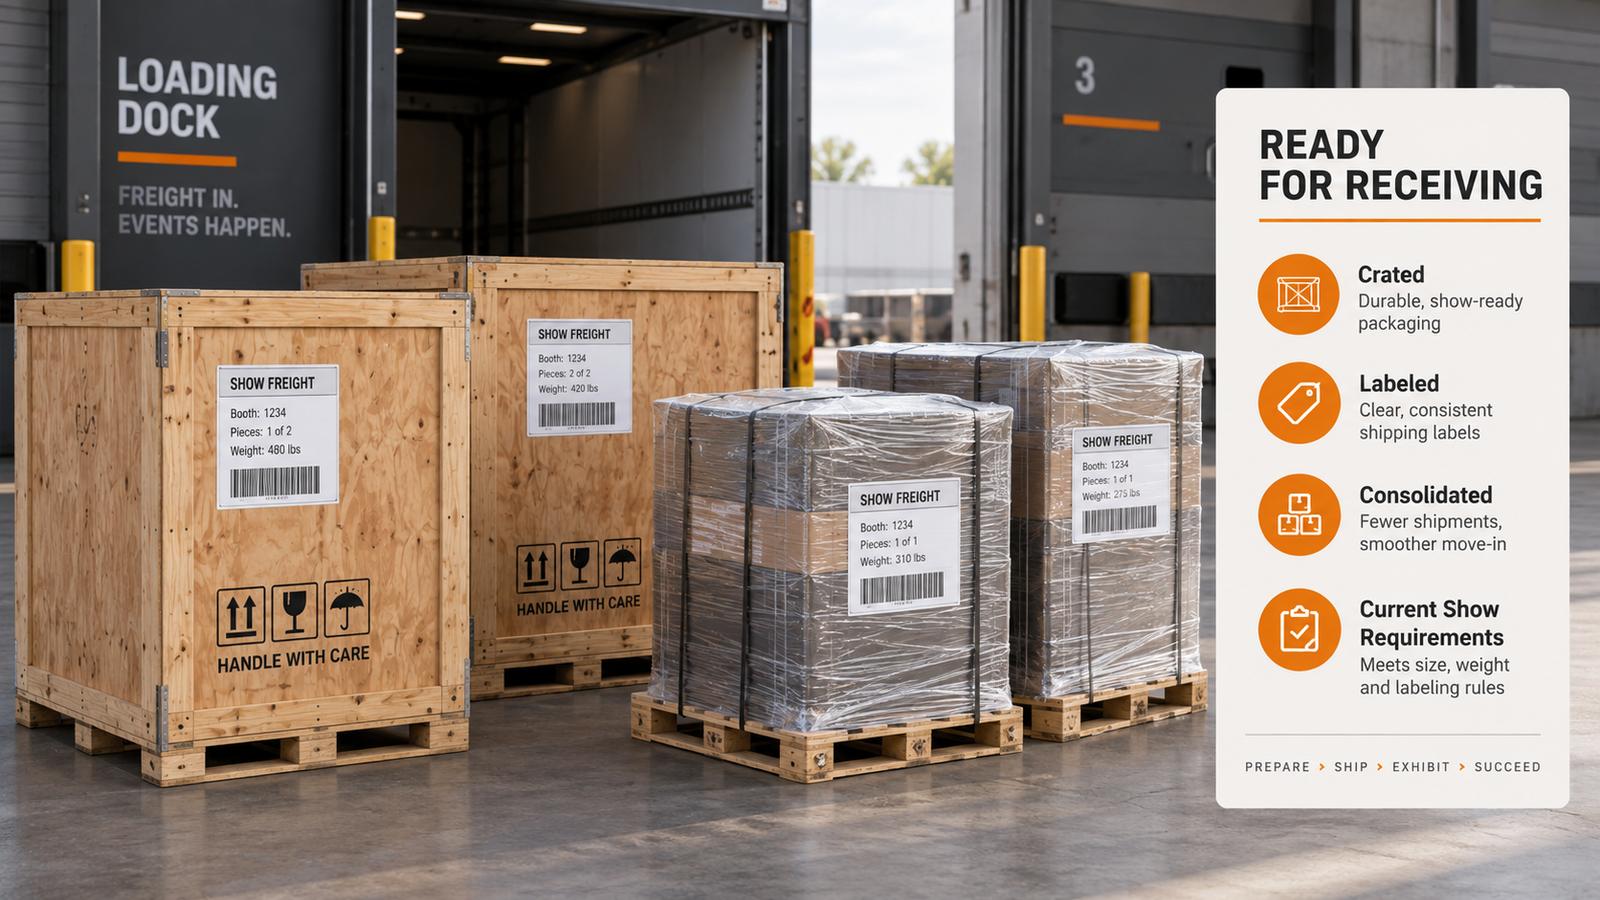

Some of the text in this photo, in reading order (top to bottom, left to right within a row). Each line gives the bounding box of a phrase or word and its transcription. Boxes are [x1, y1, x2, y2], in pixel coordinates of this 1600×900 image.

[119, 57, 276, 99] LOADING
[1076, 57, 1094, 94] 3
[119, 100, 219, 138] DOCK
[120, 186, 238, 208] FREIGHT IN.
[120, 214, 290, 237] EVENTS HAPPEN.
[539, 329, 611, 339] SHOW FREIGHT
[539, 354, 586, 363] Booth: 1234
[539, 369, 591, 378] Pieces: 2 of 2
[230, 377, 315, 390] SHOW FREIGHT
[539, 384, 599, 395] Weight: 420 lbs
[230, 408, 286, 418] Booth: 1234
[230, 426, 292, 437] Pieces: 1 of 2
[1083, 434, 1153, 448] SHOW FREIGHT
[230, 444, 301, 458] Weight: 480 lbs
[1083, 460, 1129, 471] Booth: 1234
[1083, 477, 1110, 486] Pieces:
[1120, 475, 1127, 483] of
[860, 490, 940, 506] SHOW FREIGHT
[1082, 492, 1111, 502] Weight:
[1130, 489, 1140, 497] lbs
[861, 520, 913, 533] Booth: 1234
[861, 536, 917, 550] Pieces: 1 of 1
[860, 553, 926, 568] Weight: 310 lbs
[517, 595, 640, 616] HANDLE WITH CARE
[218, 646, 370, 674] HANDLE WITH CARE
